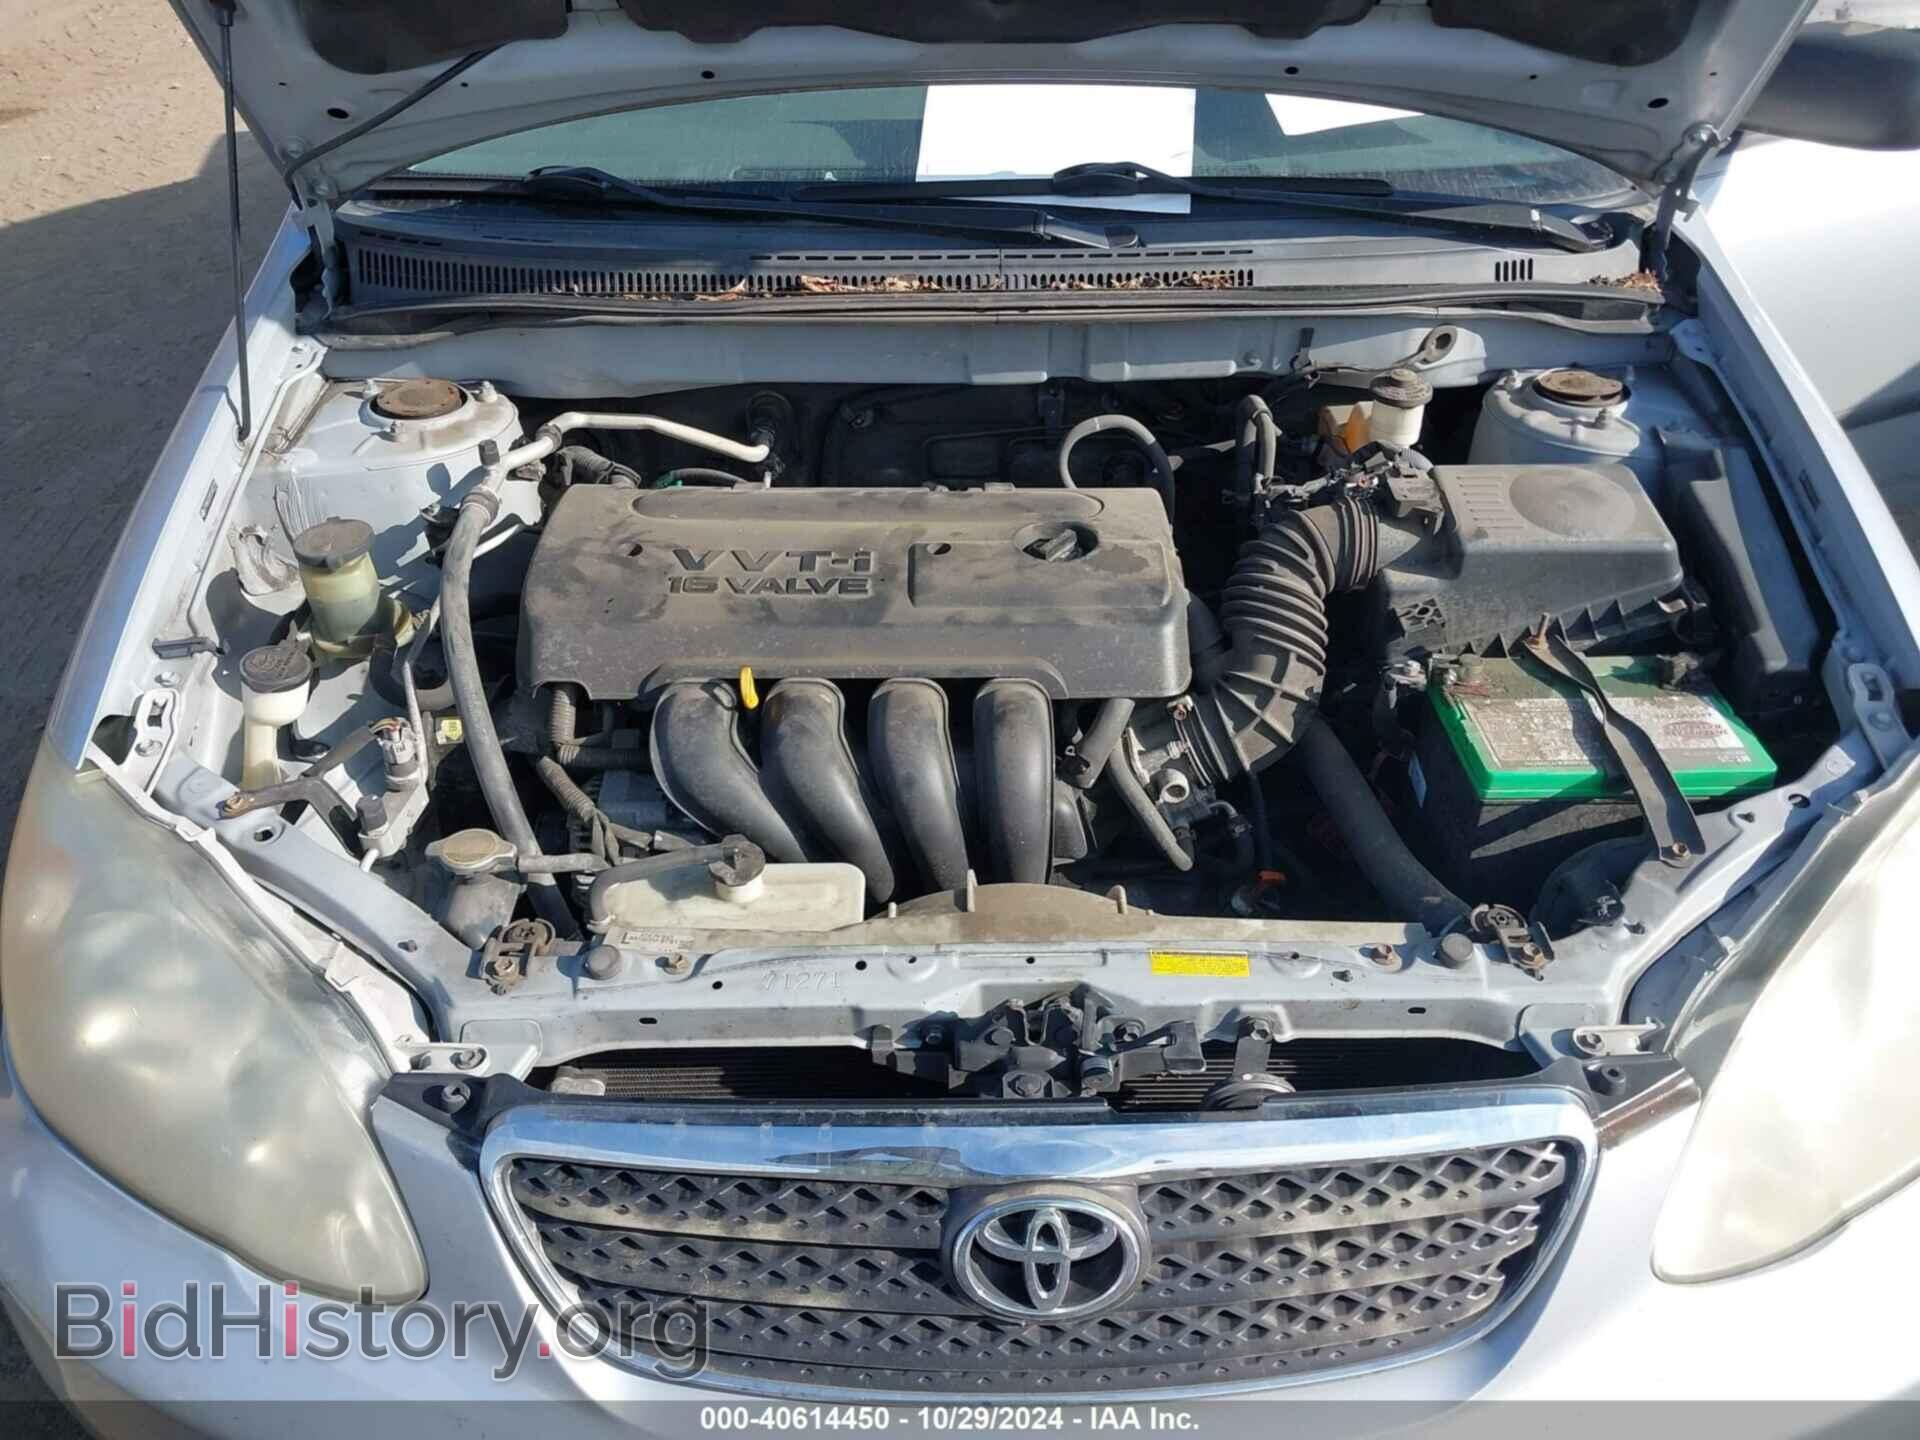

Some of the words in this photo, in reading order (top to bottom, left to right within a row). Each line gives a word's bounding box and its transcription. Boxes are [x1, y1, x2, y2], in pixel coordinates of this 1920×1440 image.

[672, 548, 873, 573] VVT-i
[668, 576, 720, 595] 16
[724, 576, 870, 595] VALVE
